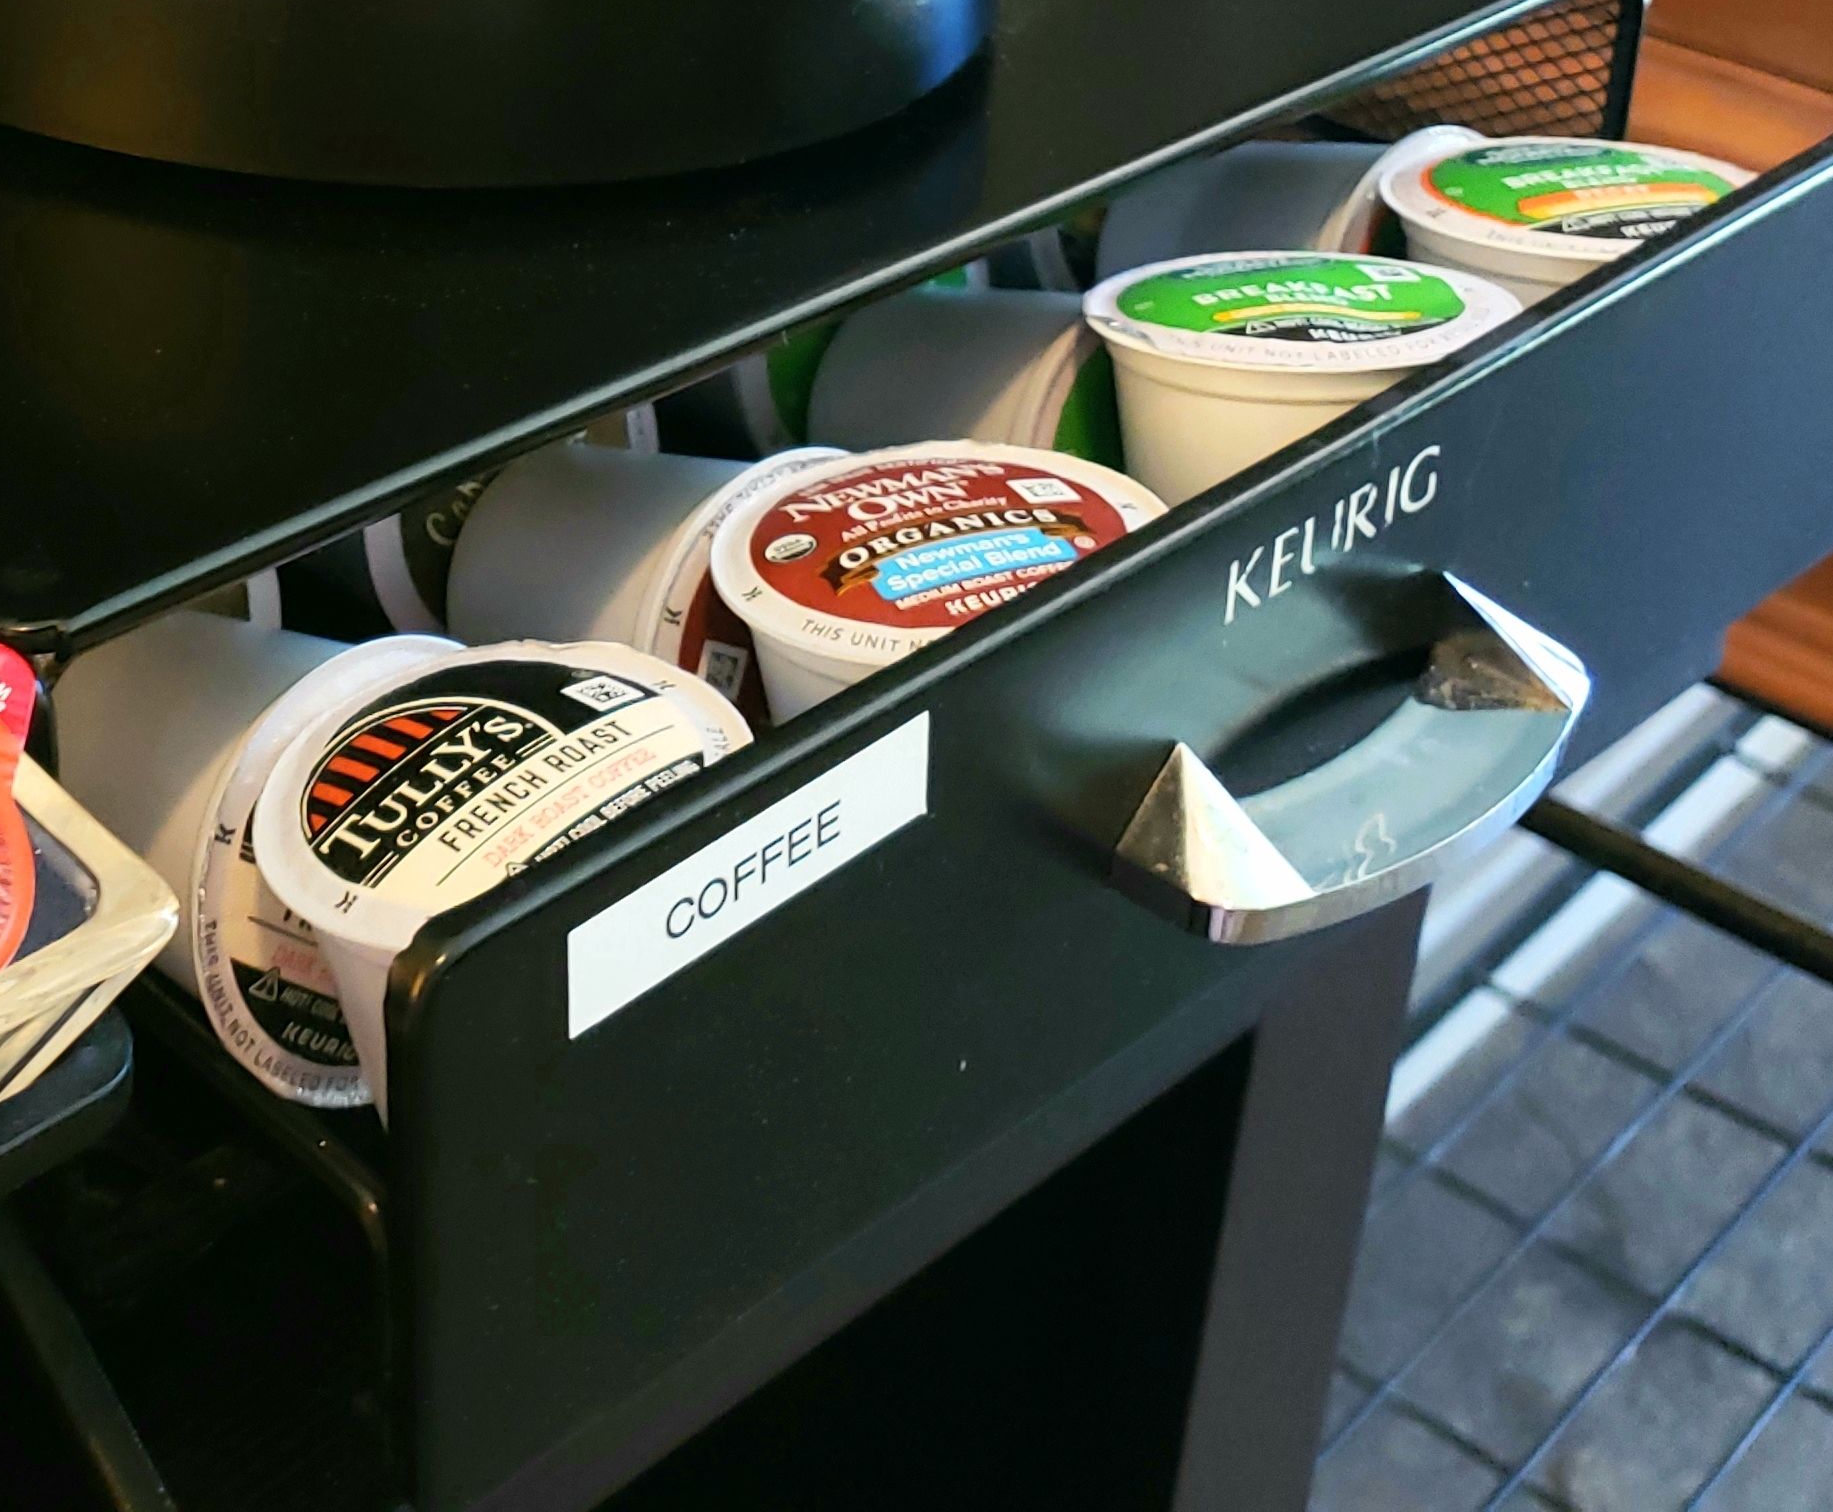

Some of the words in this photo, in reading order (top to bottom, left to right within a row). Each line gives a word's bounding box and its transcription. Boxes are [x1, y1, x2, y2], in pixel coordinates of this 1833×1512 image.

[846, 481, 970, 521] OWN
[943, 495, 1009, 513] Charity
[1223, 444, 1442, 626] KEURIG
[838, 508, 1059, 569] ORGANICS
[886, 556, 981, 592] Special
[988, 541, 1063, 567] Blend
[895, 532, 1032, 570] Newman's
[800, 617, 844, 642] THIS
[849, 630, 901, 653] UNIT
[318, 716, 525, 860] TULLY'S
[395, 752, 516, 849] COFFEE
[439, 768, 549, 853] FRENCH
[544, 719, 634, 773] ROAST
[482, 823, 536, 869] DARK
[530, 785, 592, 830] ROAST
[665, 798, 842, 939] COFFEE
